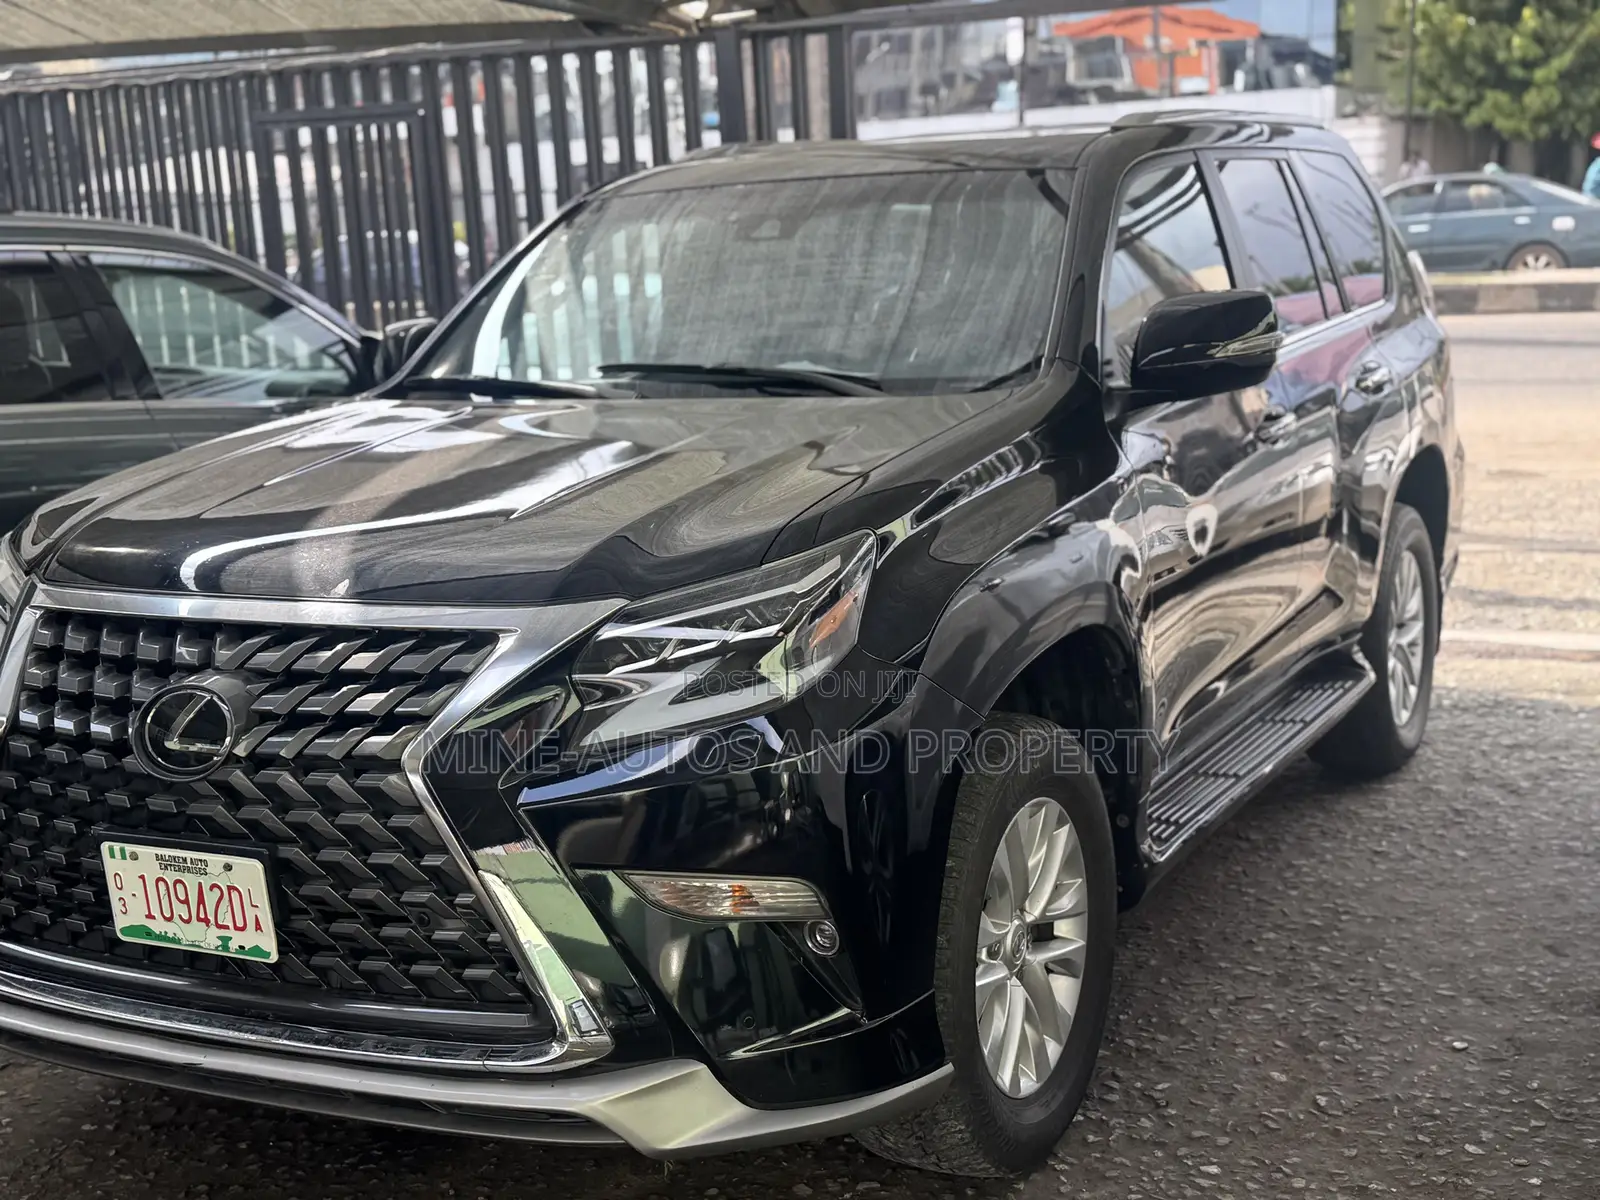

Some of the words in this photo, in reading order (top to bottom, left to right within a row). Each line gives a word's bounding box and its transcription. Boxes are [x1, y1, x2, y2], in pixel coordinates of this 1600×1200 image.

[154, 853, 188, 864] BALOKEM
[190, 857, 209, 868] AUTO
[159, 862, 208, 876] ENTERPRISES
